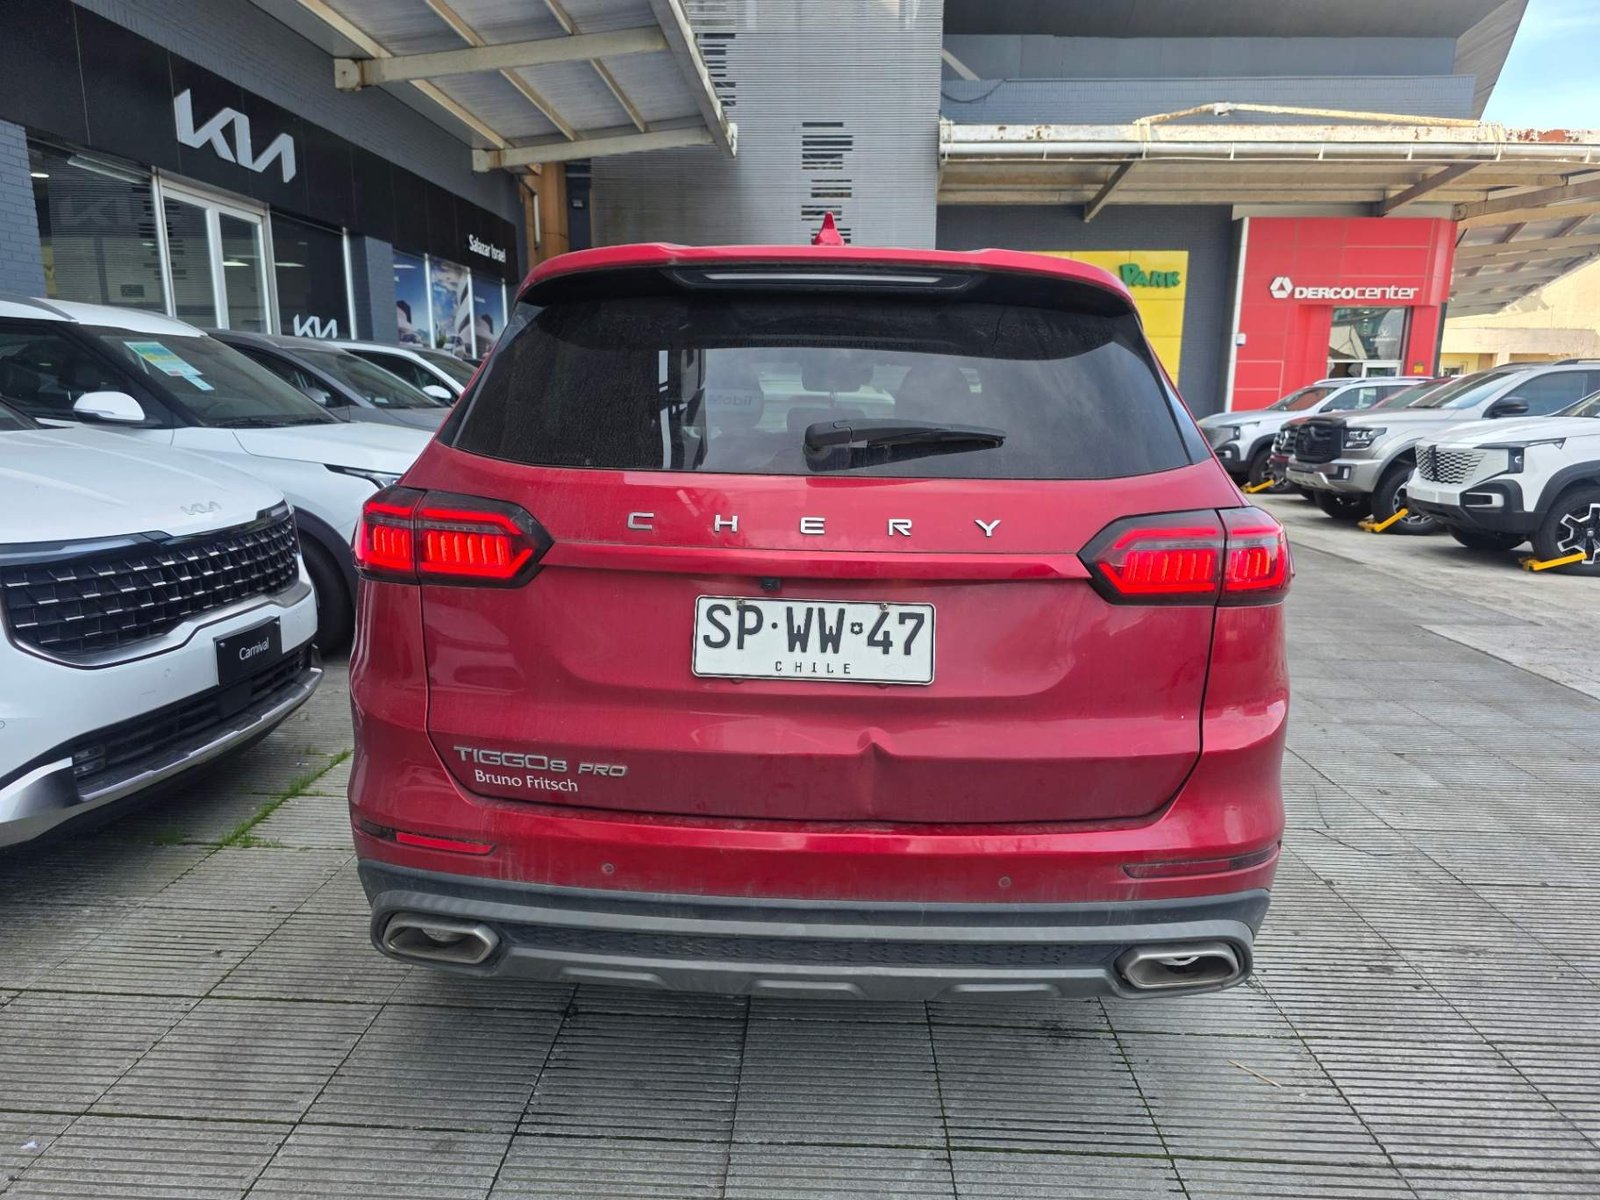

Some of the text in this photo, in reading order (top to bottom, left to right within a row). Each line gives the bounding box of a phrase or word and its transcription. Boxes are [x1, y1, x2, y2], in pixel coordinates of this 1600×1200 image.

[173, 88, 296, 183] KIA
[469, 234, 506, 263] Salazar Israel
[627, 512, 1002, 537] CHERY
[239, 637, 270, 660] Carnival
[775, 661, 851, 675] CHILE
[474, 769, 579, 792] Bruno Fritsch
[578, 763, 628, 777] PRO
